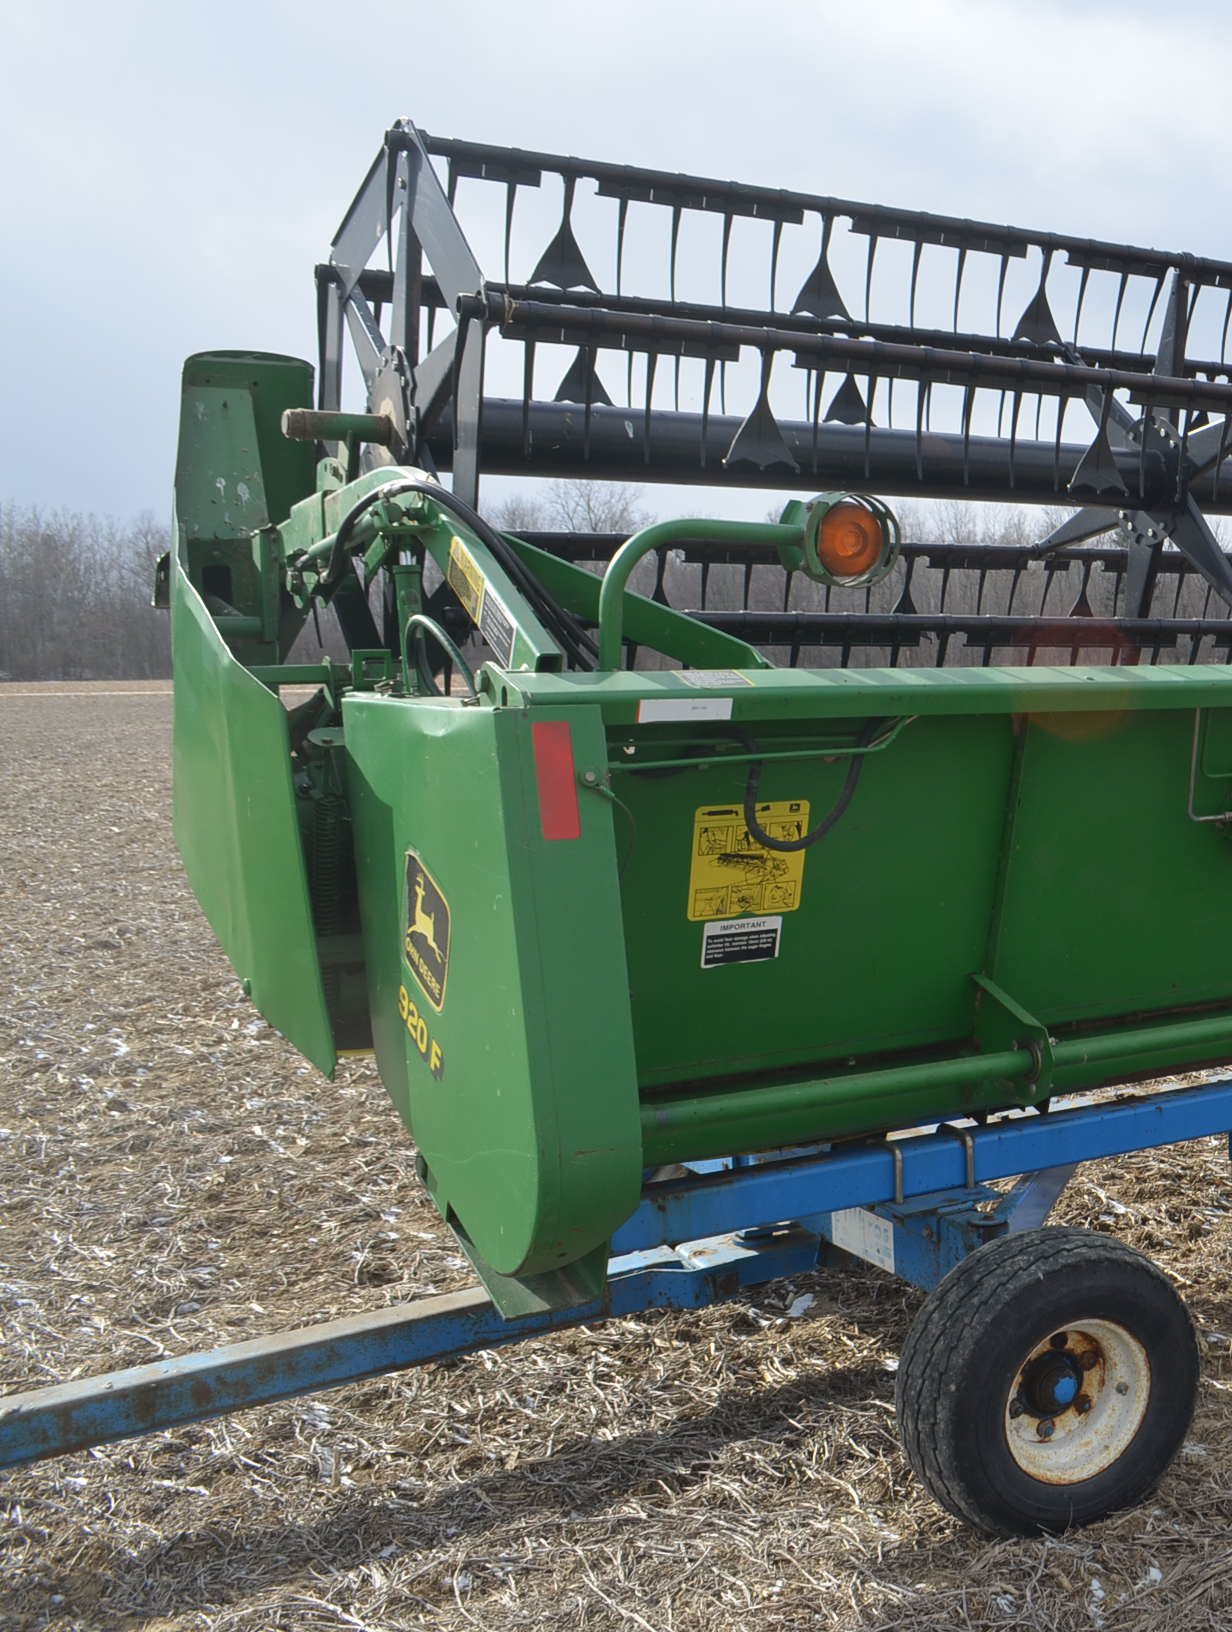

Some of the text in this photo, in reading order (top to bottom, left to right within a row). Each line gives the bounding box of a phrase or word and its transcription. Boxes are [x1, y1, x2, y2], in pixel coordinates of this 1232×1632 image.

[720, 920, 767, 930] IMPORTANT
[404, 937, 441, 1000] OHN DEERE
[399, 985, 443, 1072] 920 F
